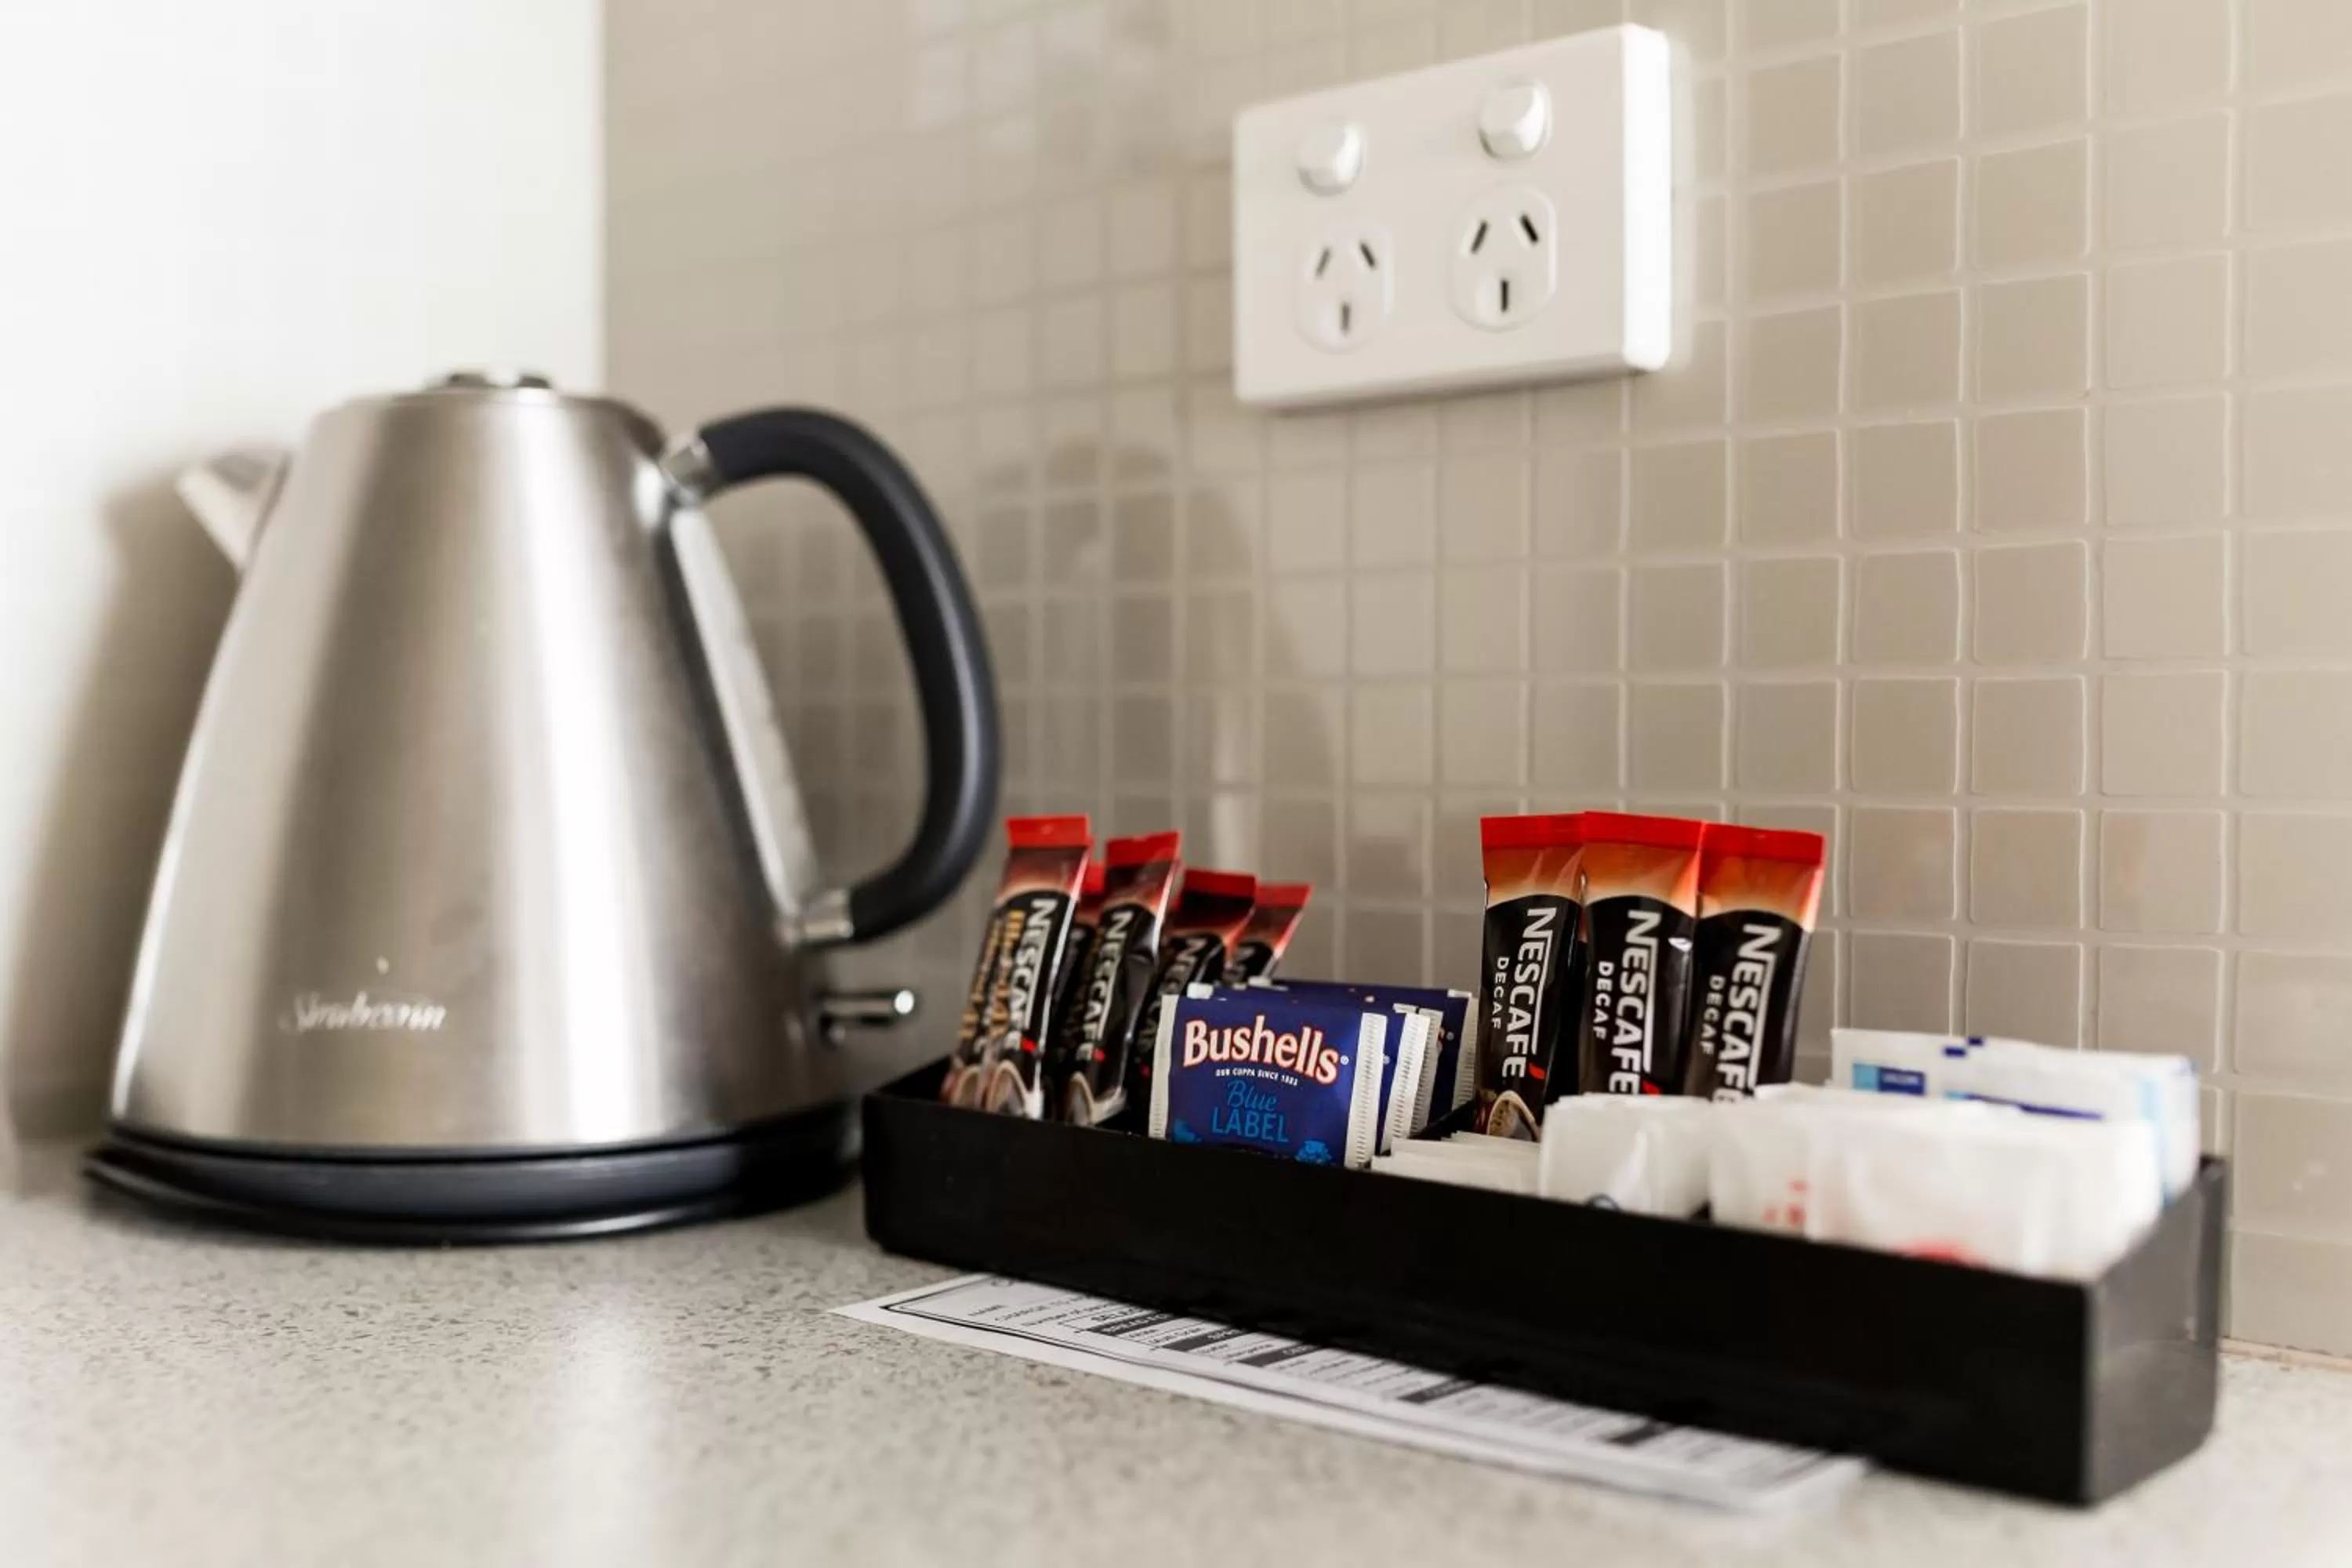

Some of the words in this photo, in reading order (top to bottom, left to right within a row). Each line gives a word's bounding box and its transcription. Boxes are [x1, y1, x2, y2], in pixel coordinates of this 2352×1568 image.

[1492, 956, 1510, 1029] DECAF
[1593, 960, 1615, 1040] DECAF
[1700, 974, 1726, 1055] DECAF
[1182, 1014, 1340, 1085] Bushells
[1232, 1066, 1255, 1077] CUPPA
[1257, 1068, 1279, 1081] SINCE
[1211, 1105, 1289, 1143] LABEL
[1227, 1079, 1277, 1112] Blue
